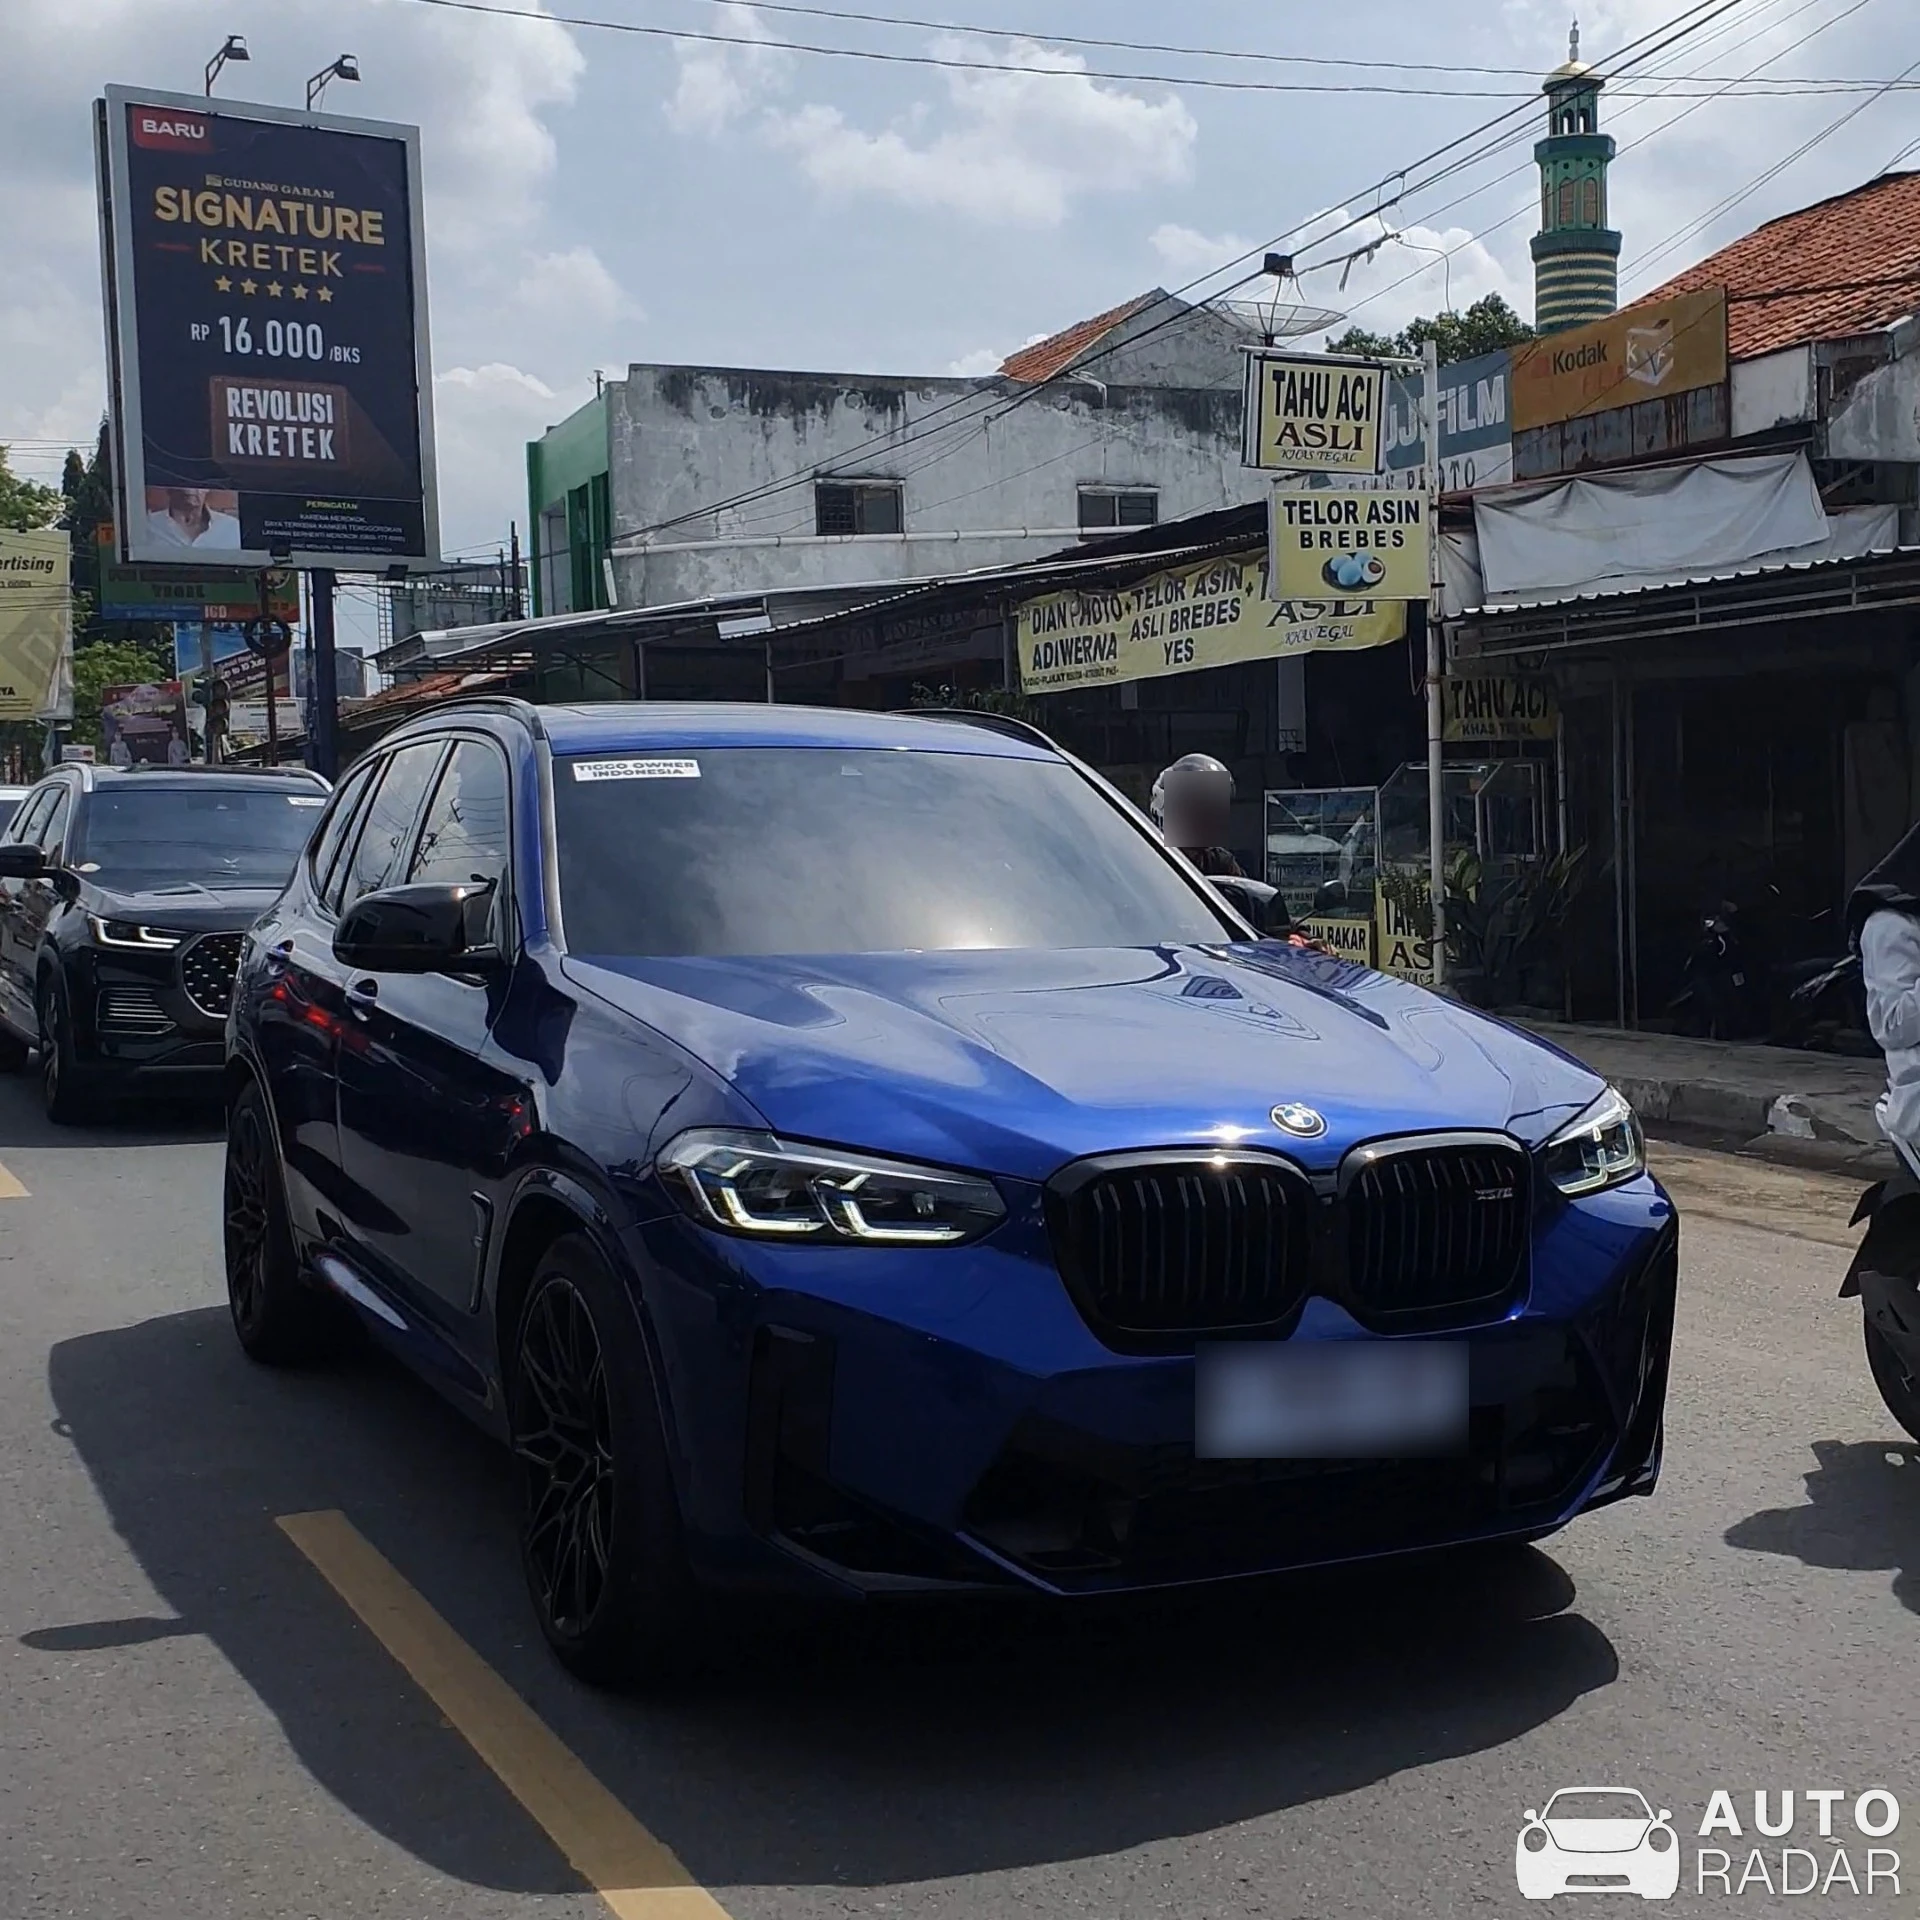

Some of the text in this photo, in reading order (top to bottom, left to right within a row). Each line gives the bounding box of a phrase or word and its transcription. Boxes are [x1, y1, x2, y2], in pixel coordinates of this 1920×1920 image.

[142, 119, 205, 139] BARU
[223, 176, 335, 199] GUDANG GARAM
[155, 186, 385, 246] SIGNATURE
[201, 238, 344, 278] KRETEK
[191, 315, 361, 364] RP 16.000 /BKS
[1552, 340, 1608, 375] Kodak
[226, 387, 334, 424] REVOLUSI
[1272, 369, 1373, 422] TAHU ACI
[1385, 374, 1506, 451] UJIFILM
[228, 422, 336, 461] KRETEK
[1274, 422, 1364, 451] ASLI
[1280, 449, 1358, 463] KHAS TEGAL
[306, 500, 358, 510] PERINGATAN
[1282, 499, 1421, 525] TELOR ASIN
[1299, 529, 1405, 550] BREBES
[204, 604, 228, 619] IGD
[1032, 601, 1067, 635] DIAN
[1130, 577, 1187, 612] TELOR
[1192, 566, 1244, 599] ASIN
[1265, 600, 1377, 628] ASLI
[1129, 597, 1241, 642] ASLI BREBES
[1316, 625, 1354, 643] EGAL
[1032, 631, 1118, 671] ADIWERNA
[1163, 637, 1194, 665] YES
[1451, 678, 1549, 719] TAHU ACI
[1462, 723, 1496, 736] KHAS
[592, 768, 683, 778] INDONESIA
[632, 761, 696, 770] OWNER
[1328, 926, 1367, 951] BAKAR
